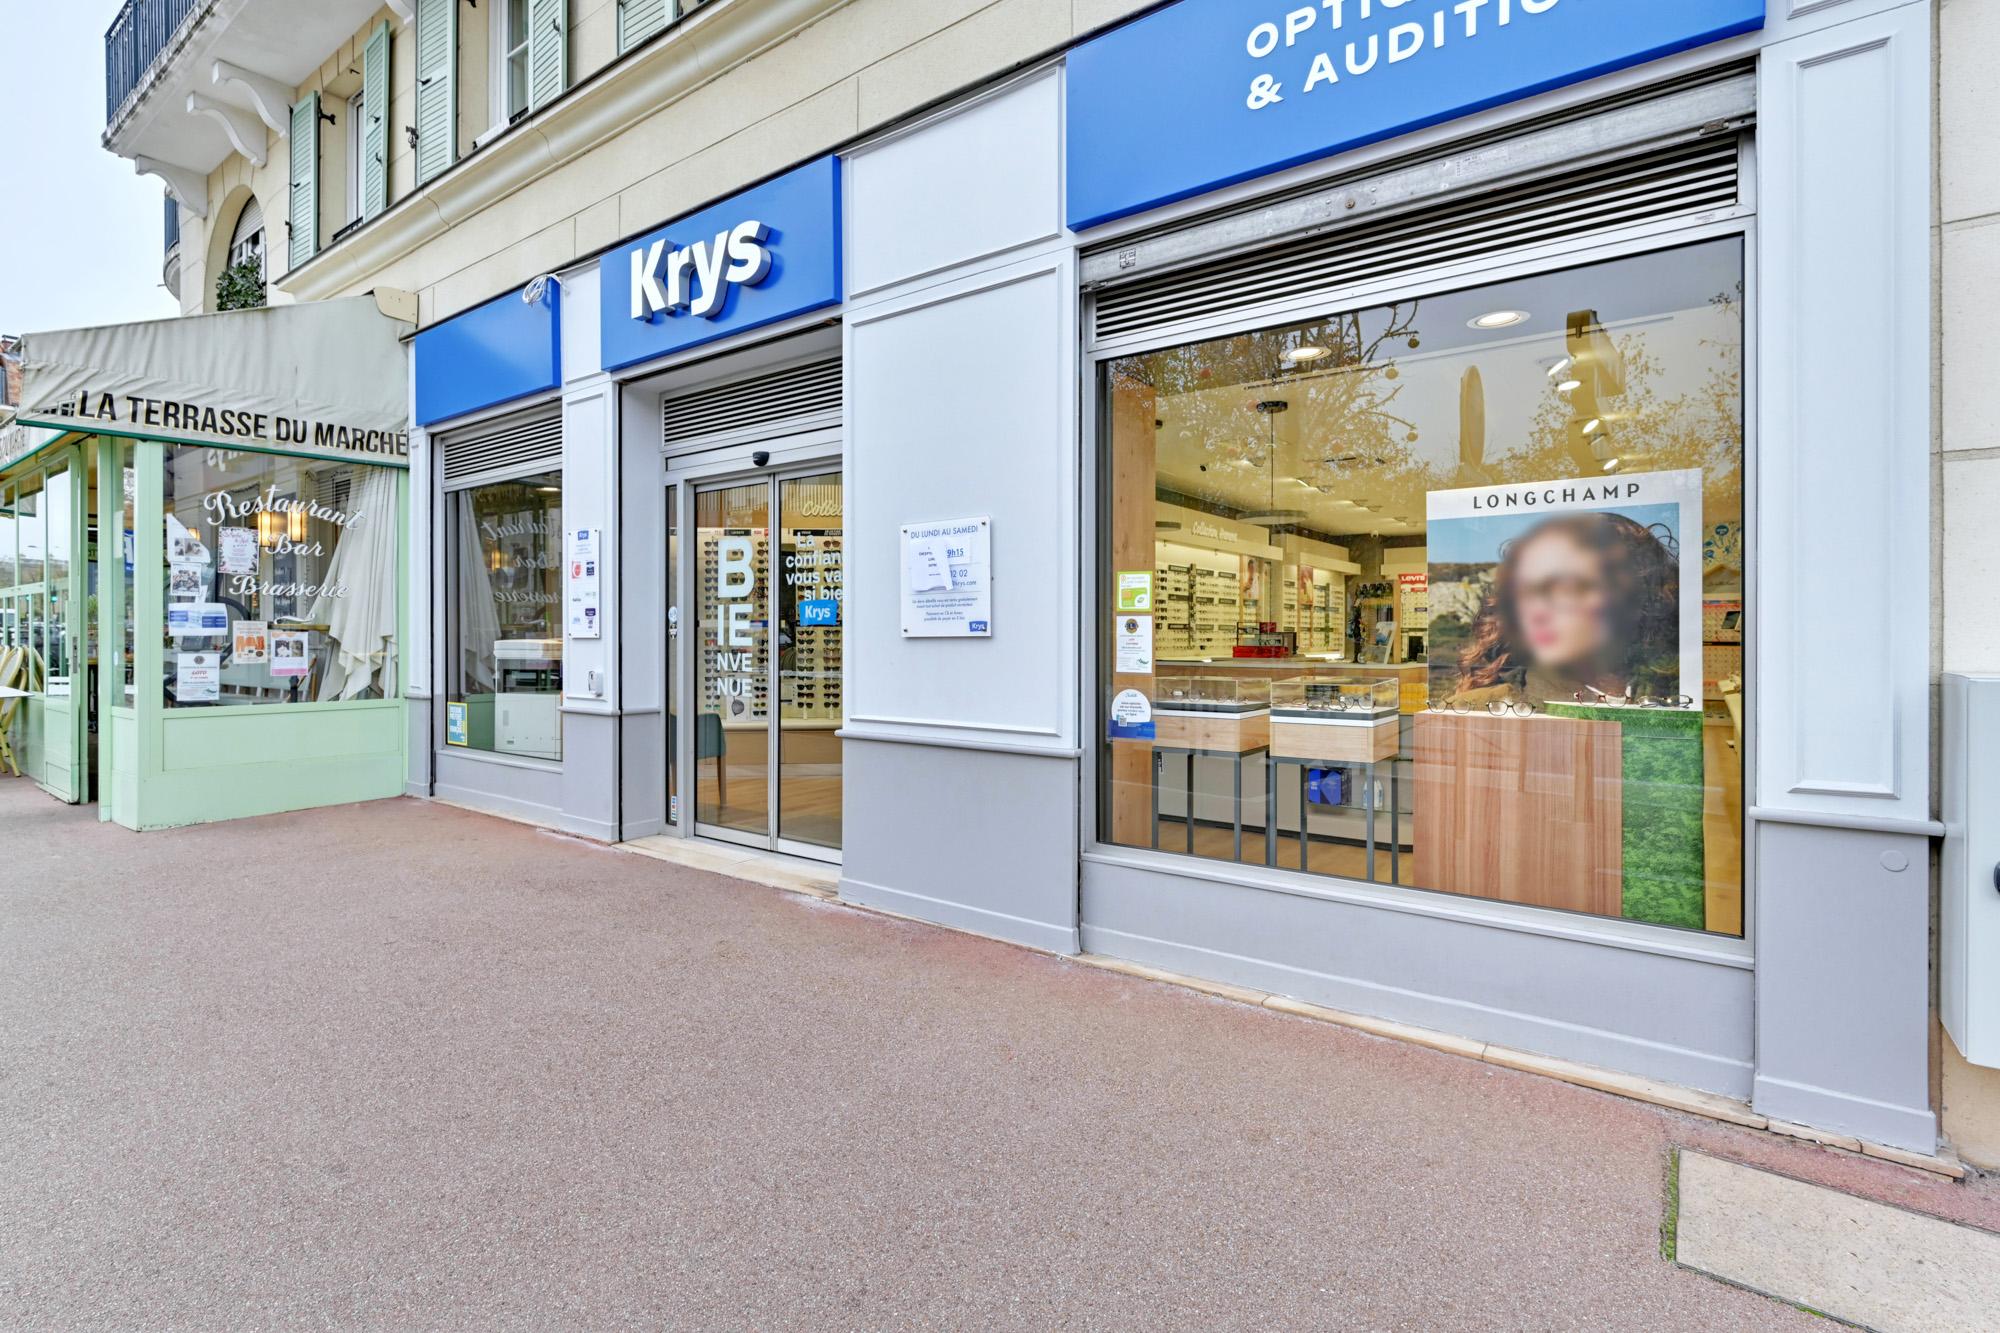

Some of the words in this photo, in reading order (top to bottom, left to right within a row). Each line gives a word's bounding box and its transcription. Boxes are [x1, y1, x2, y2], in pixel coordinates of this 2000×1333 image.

[1246, 0, 1416, 58] OPTI
[1246, 73, 1284, 110] &
[631, 220, 768, 319] Krys
[79, 390, 116, 420] LA
[126, 396, 268, 439] TERRASSE
[275, 417, 307, 443] DU
[203, 484, 367, 530] Restaurant
[1473, 483, 1641, 509] LONGCHAMP
[910, 531, 920, 539] DU
[921, 528, 940, 538] LUNDI
[941, 528, 951, 536] AU
[952, 525, 978, 535] SAMEDI
[265, 533, 325, 557] Bar
[947, 548, 964, 557] 9h15
[718, 538, 754, 598] B
[785, 570, 821, 585] vous
[228, 574, 351, 599] Brasserie
[804, 586, 816, 602] si
[804, 604, 830, 620] Krys
[717, 604, 753, 646] IE
[717, 653, 752, 672] NVE
[717, 678, 752, 697] NUE
